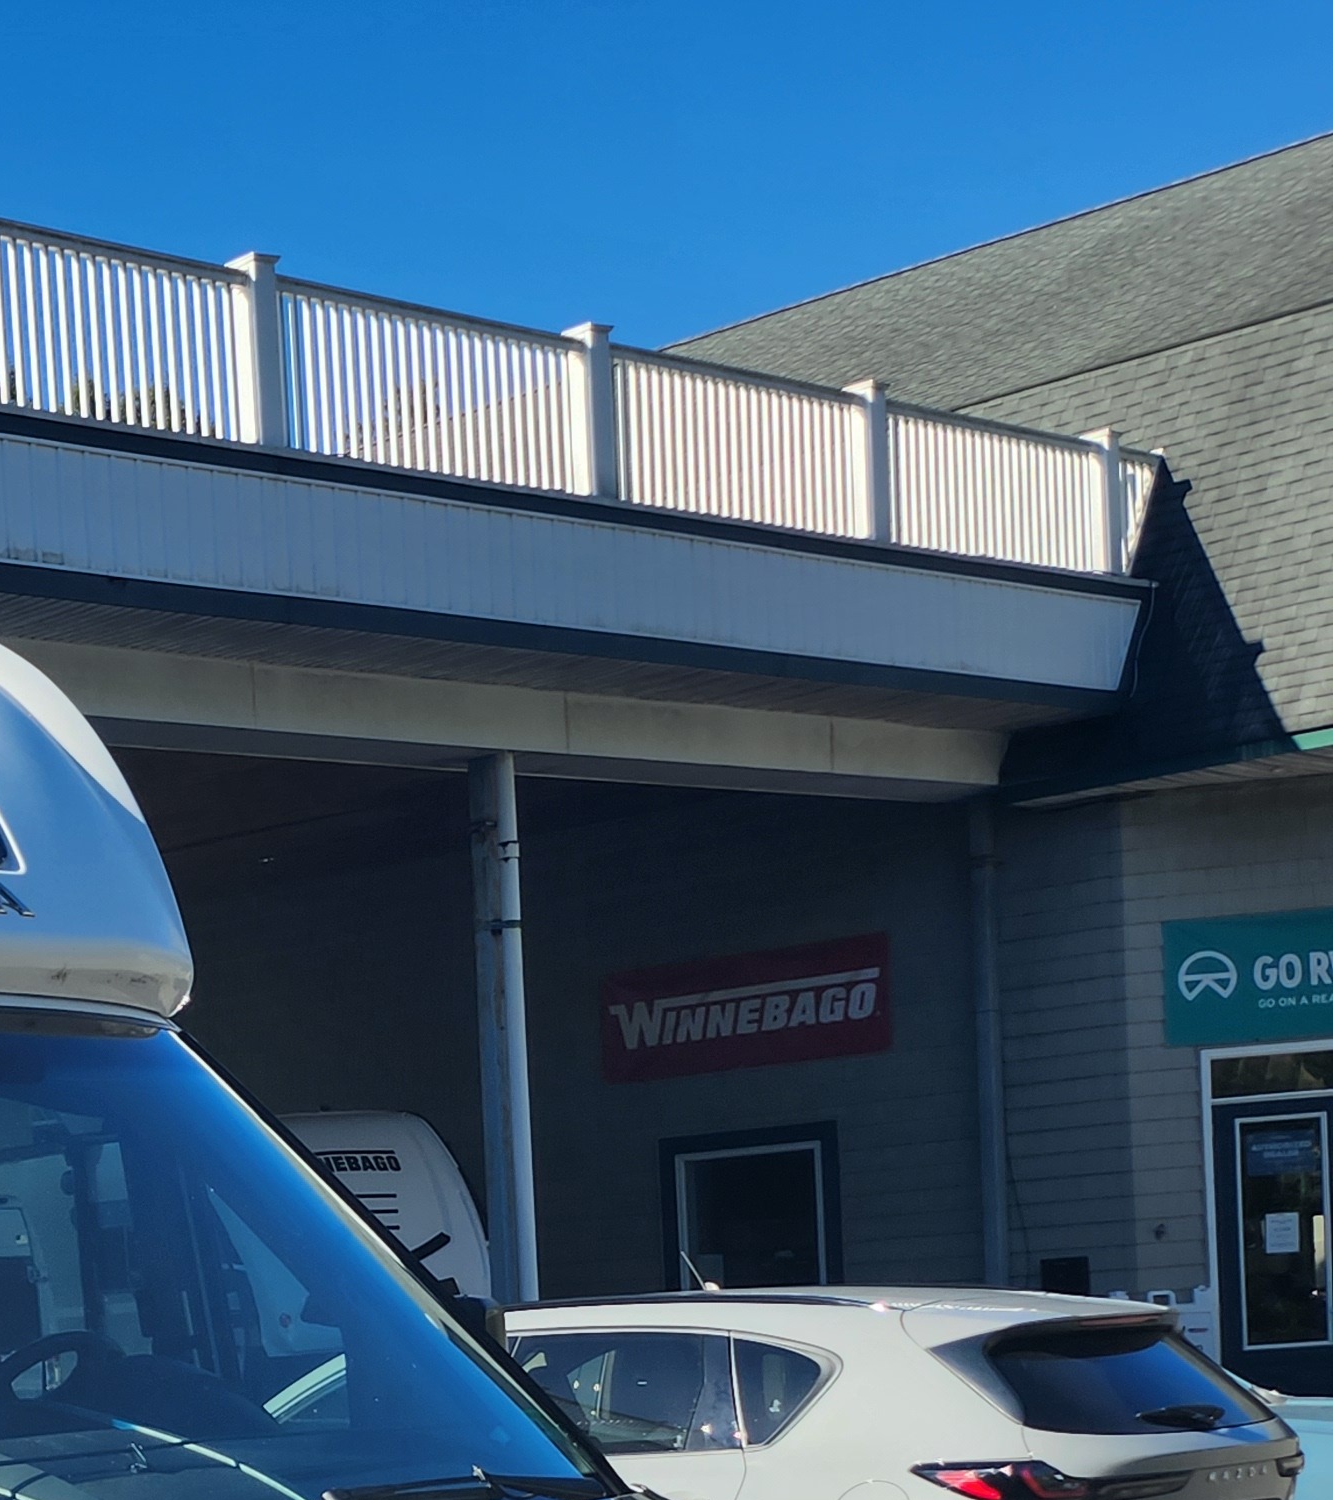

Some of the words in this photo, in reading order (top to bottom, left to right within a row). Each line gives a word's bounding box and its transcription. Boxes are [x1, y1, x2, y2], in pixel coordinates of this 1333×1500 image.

[1253, 953, 1303, 991] GO
[1308, 950, 1333, 986] R
[608, 966, 882, 1051] WINNEBAGO
[1258, 998, 1276, 1009] GO
[1278, 996, 1297, 1007] ON
[1300, 994, 1309, 1006] A
[1207, 1465, 1268, 1481] MAZDA
